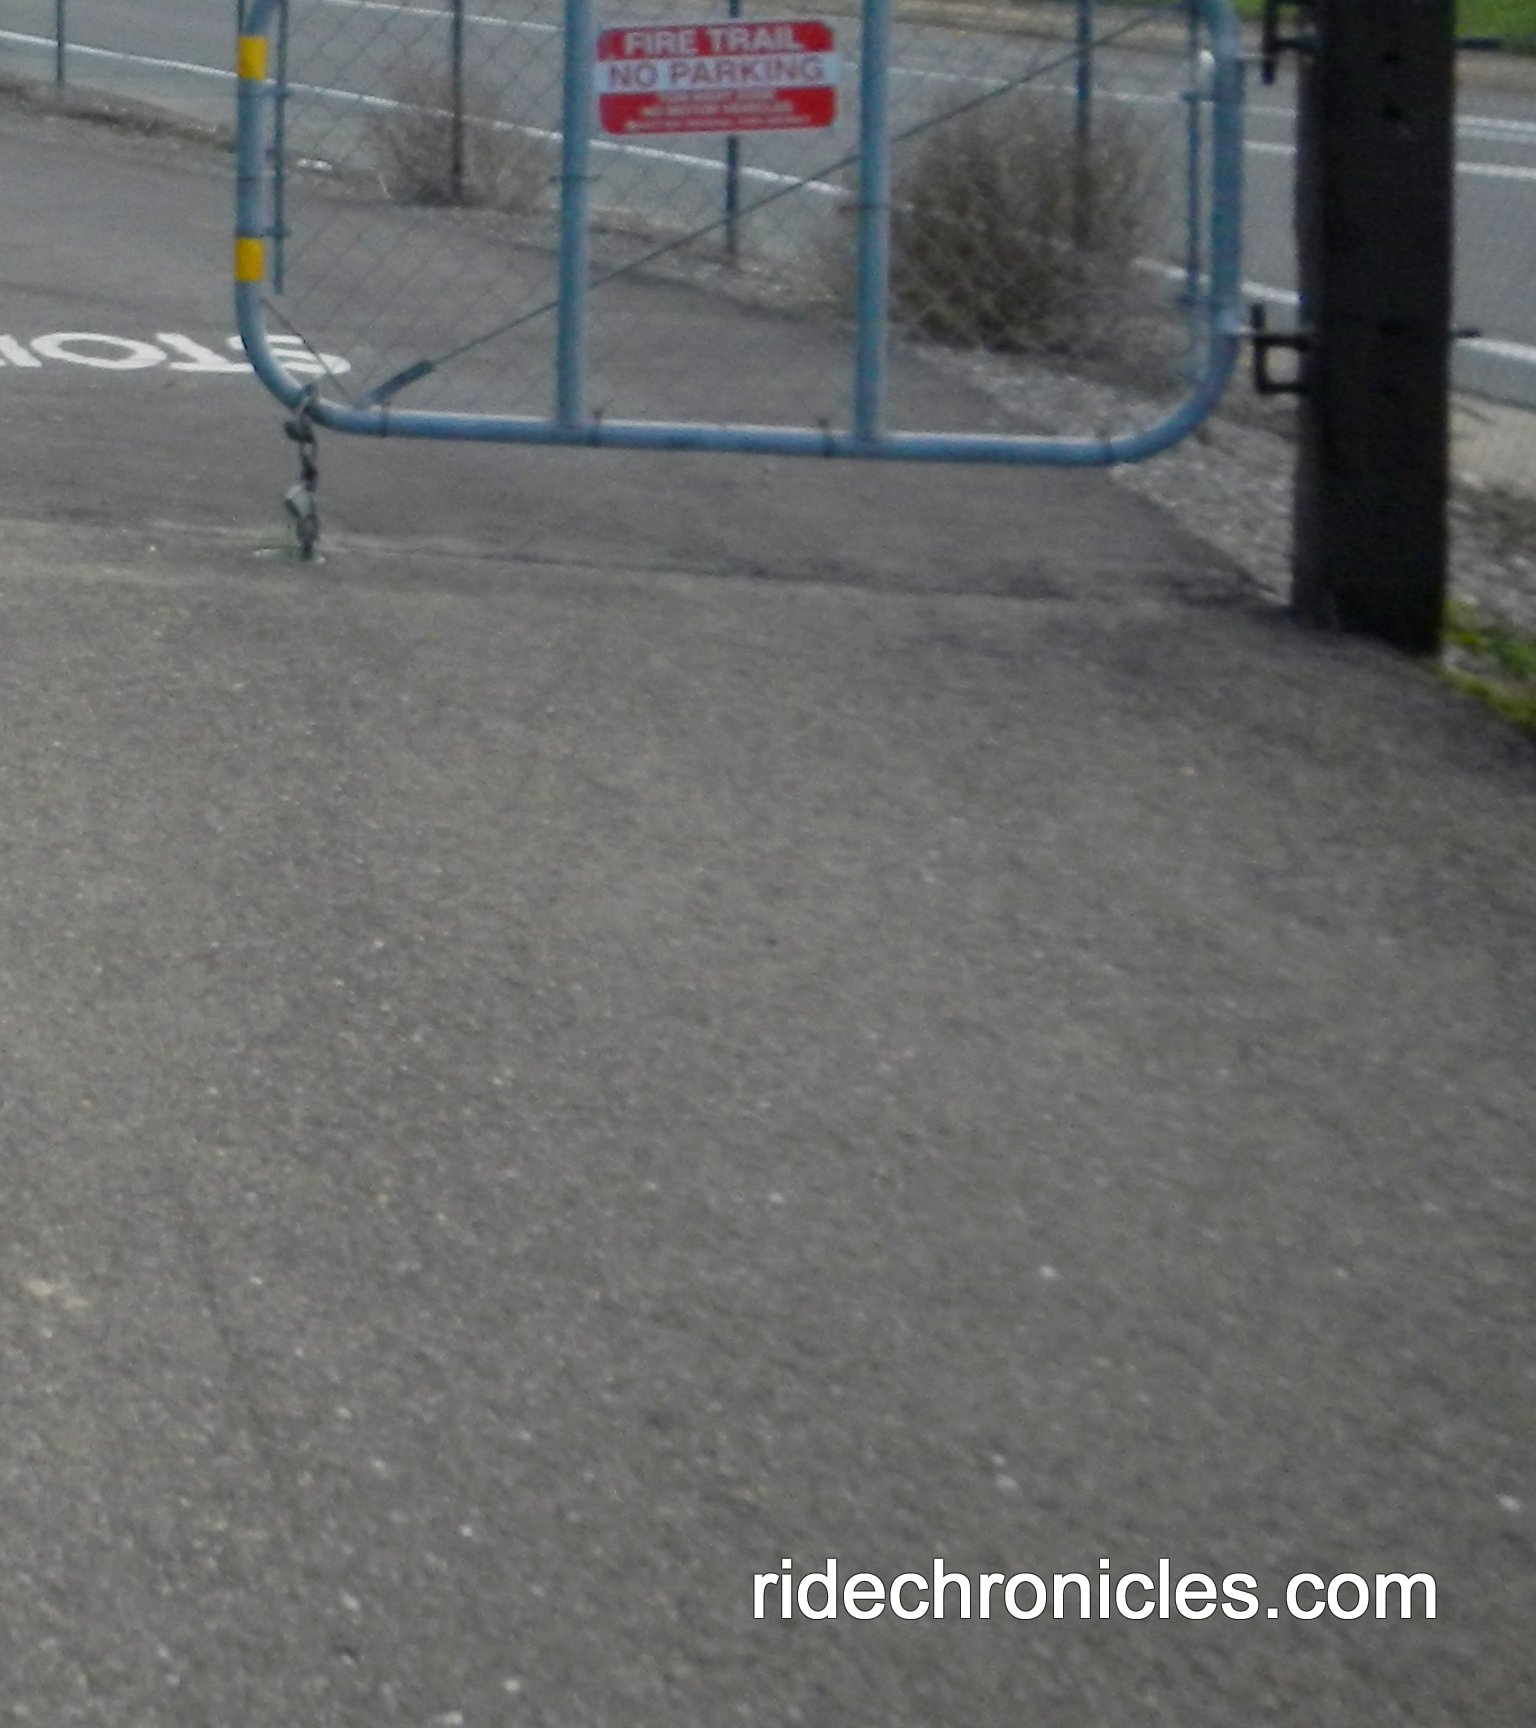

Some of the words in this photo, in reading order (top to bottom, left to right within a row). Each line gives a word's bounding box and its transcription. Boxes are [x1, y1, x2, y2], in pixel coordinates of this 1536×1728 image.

[624, 30, 697, 58] FIRE
[707, 25, 802, 54] TRAIL
[609, 63, 658, 89] NO
[669, 53, 824, 84] PARKING
